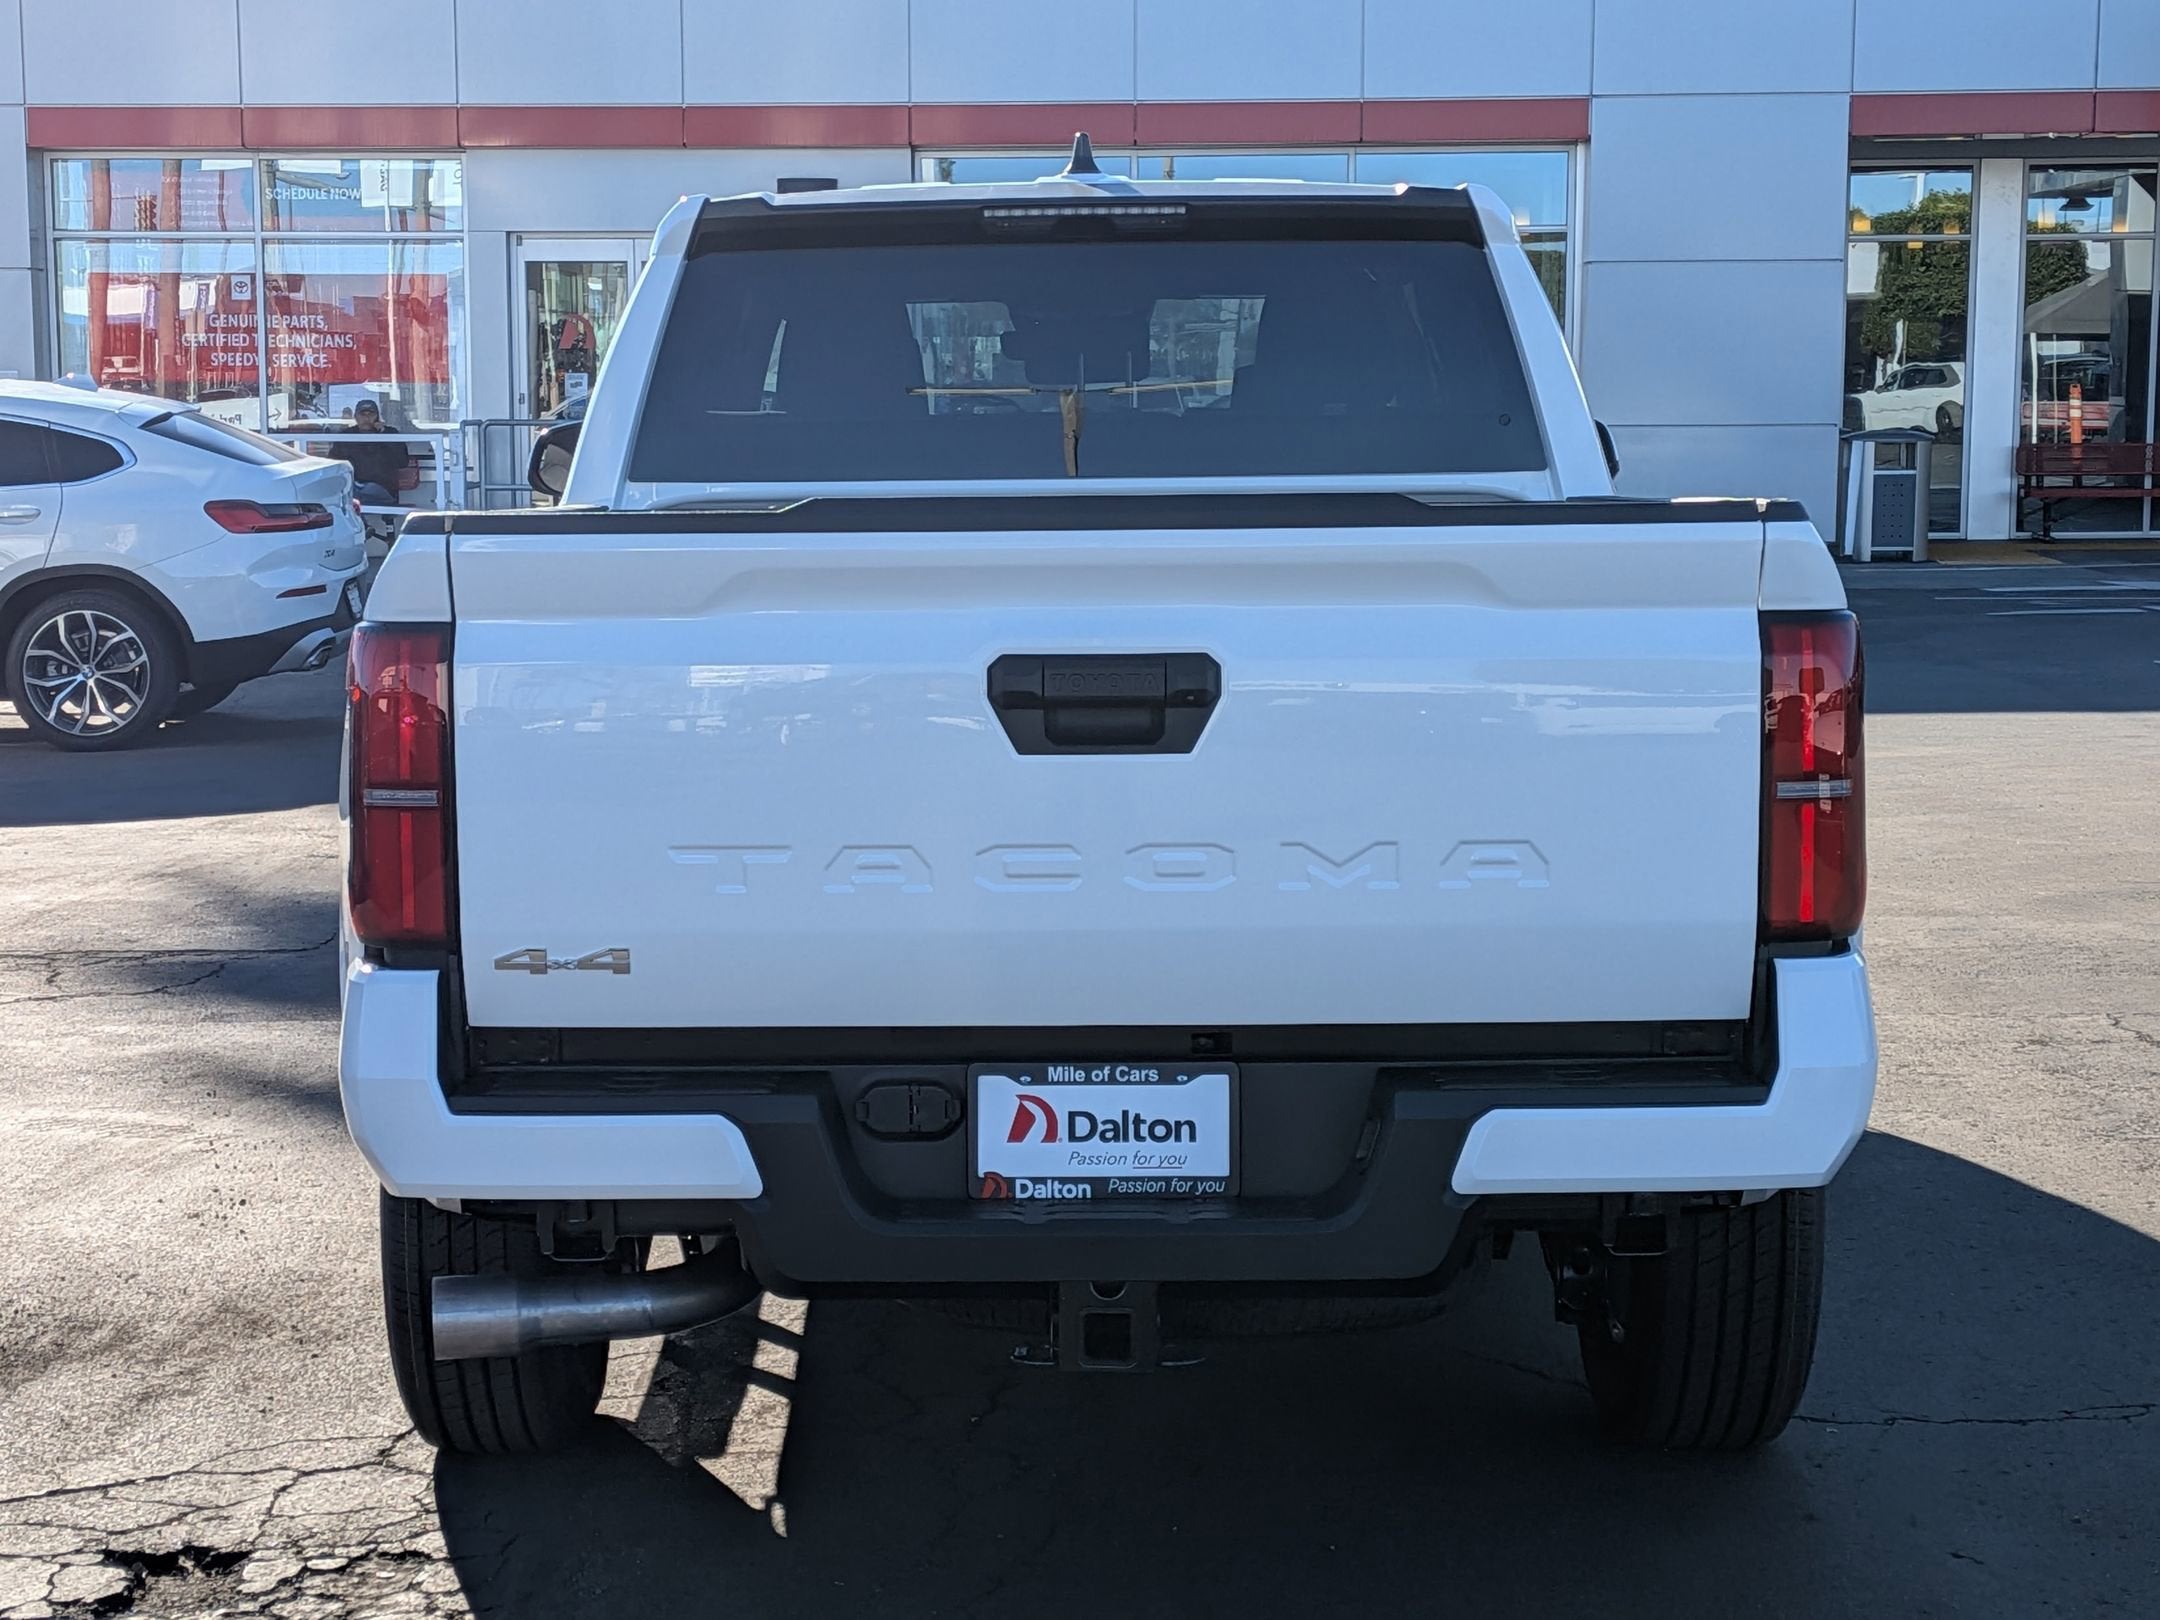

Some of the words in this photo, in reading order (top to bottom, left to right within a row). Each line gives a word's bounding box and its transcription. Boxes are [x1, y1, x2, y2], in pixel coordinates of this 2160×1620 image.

[265, 188, 328, 200] SCHEDULE
[330, 188, 361, 200] NOW
[209, 313, 280, 328] GENUINE
[282, 314, 329, 330] PARTS,
[181, 333, 249, 347] CERTIFIED
[210, 352, 261, 367] SPEEDY
[1050, 672, 1159, 693] TOYOTA
[667, 837, 1551, 895] TACOMA
[1048, 1067, 1088, 1082] Mile
[1091, 1067, 1110, 1082] of
[1115, 1067, 1159, 1082] Cars
[1067, 1110, 1197, 1143] Dalton
[1068, 1152, 1133, 1166] Passion
[1133, 1152, 1154, 1166] for
[1158, 1154, 1188, 1168] you
[1015, 1180, 1091, 1199] Dalton
[1108, 1179, 1166, 1192] Passion
[1171, 1179, 1191, 1192] for
[1194, 1181, 1226, 1195] you
